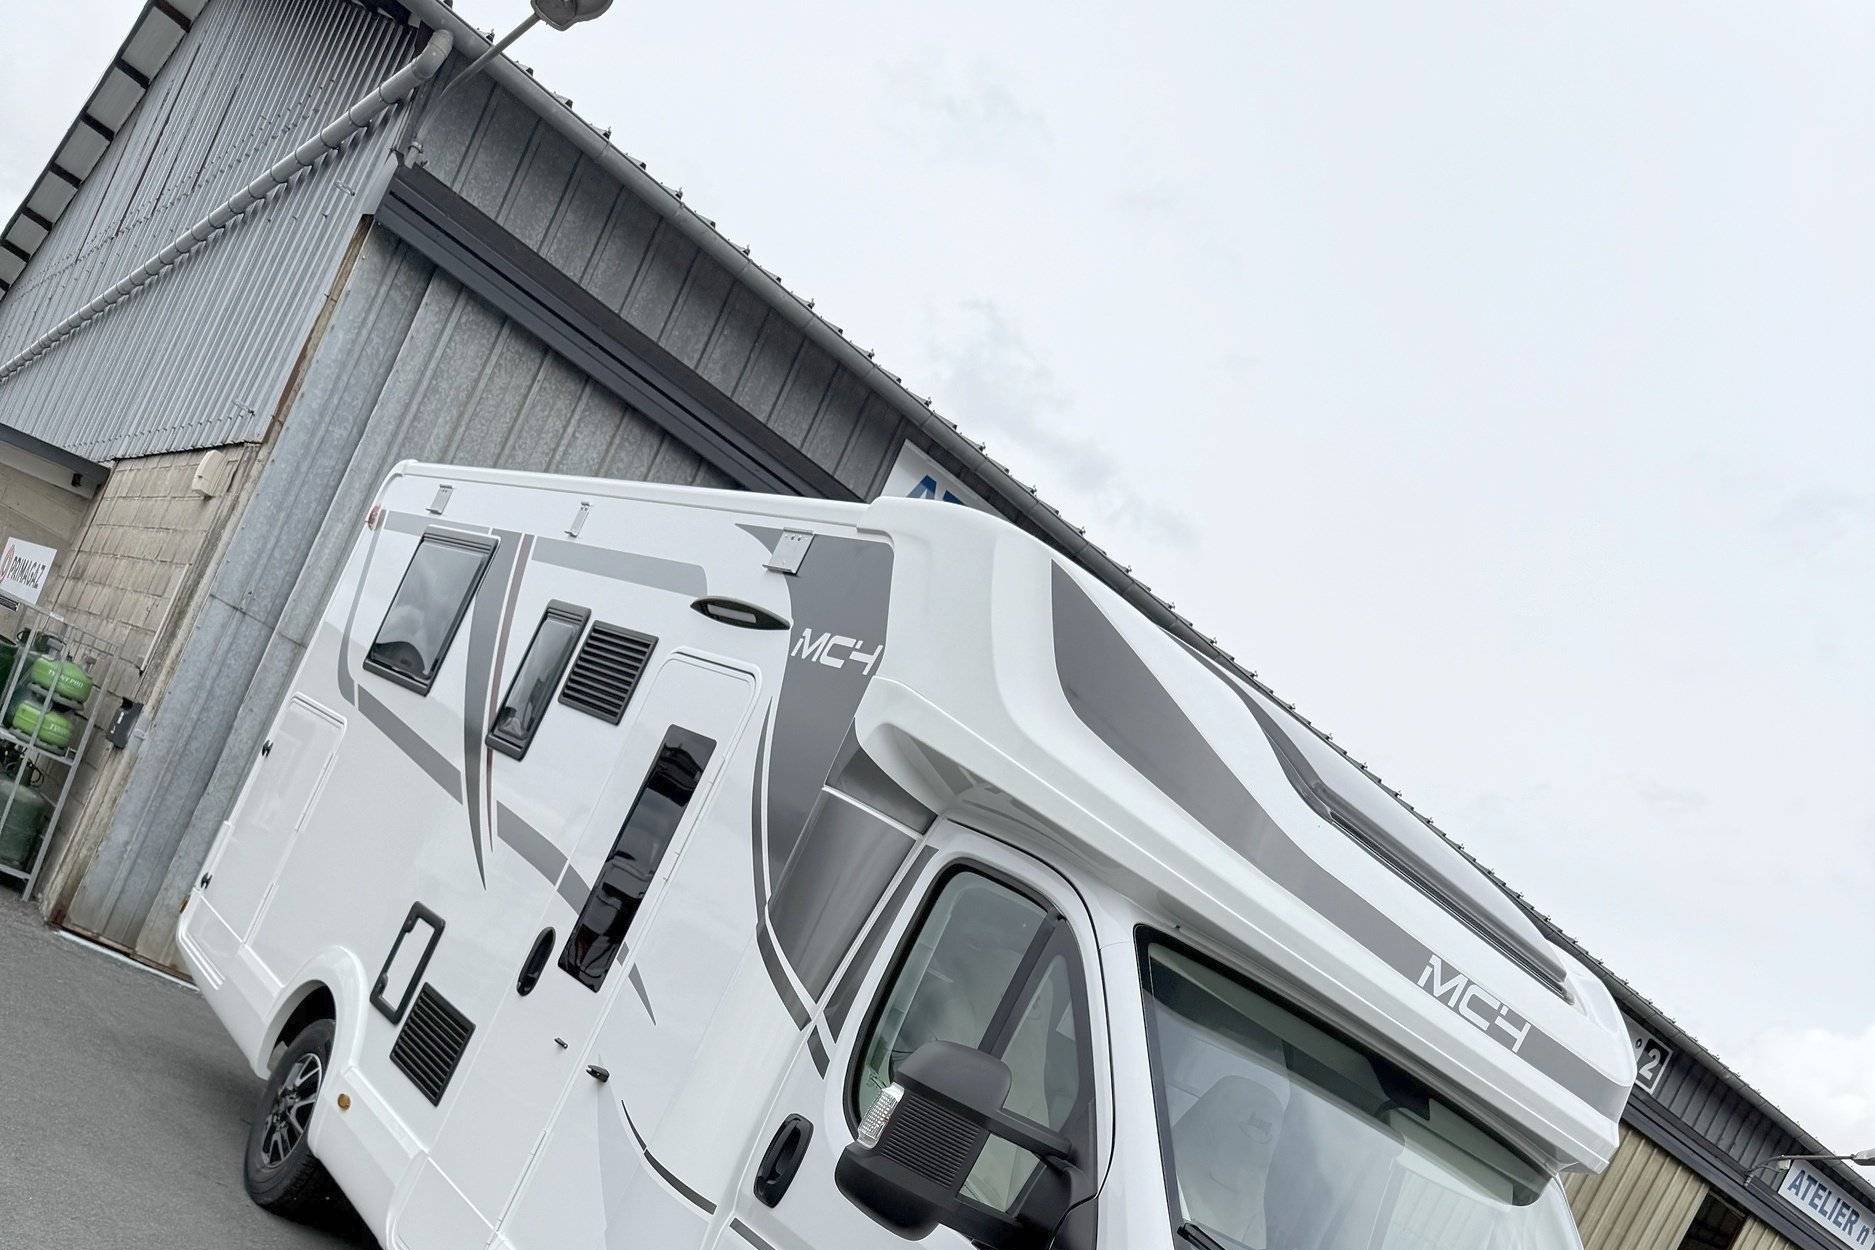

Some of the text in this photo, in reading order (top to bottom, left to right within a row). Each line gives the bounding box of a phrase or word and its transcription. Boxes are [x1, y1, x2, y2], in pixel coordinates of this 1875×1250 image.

[791, 628, 884, 675] MC4
[1417, 954, 1532, 1054] MC4
[1787, 1169, 1860, 1237] ATELIER
